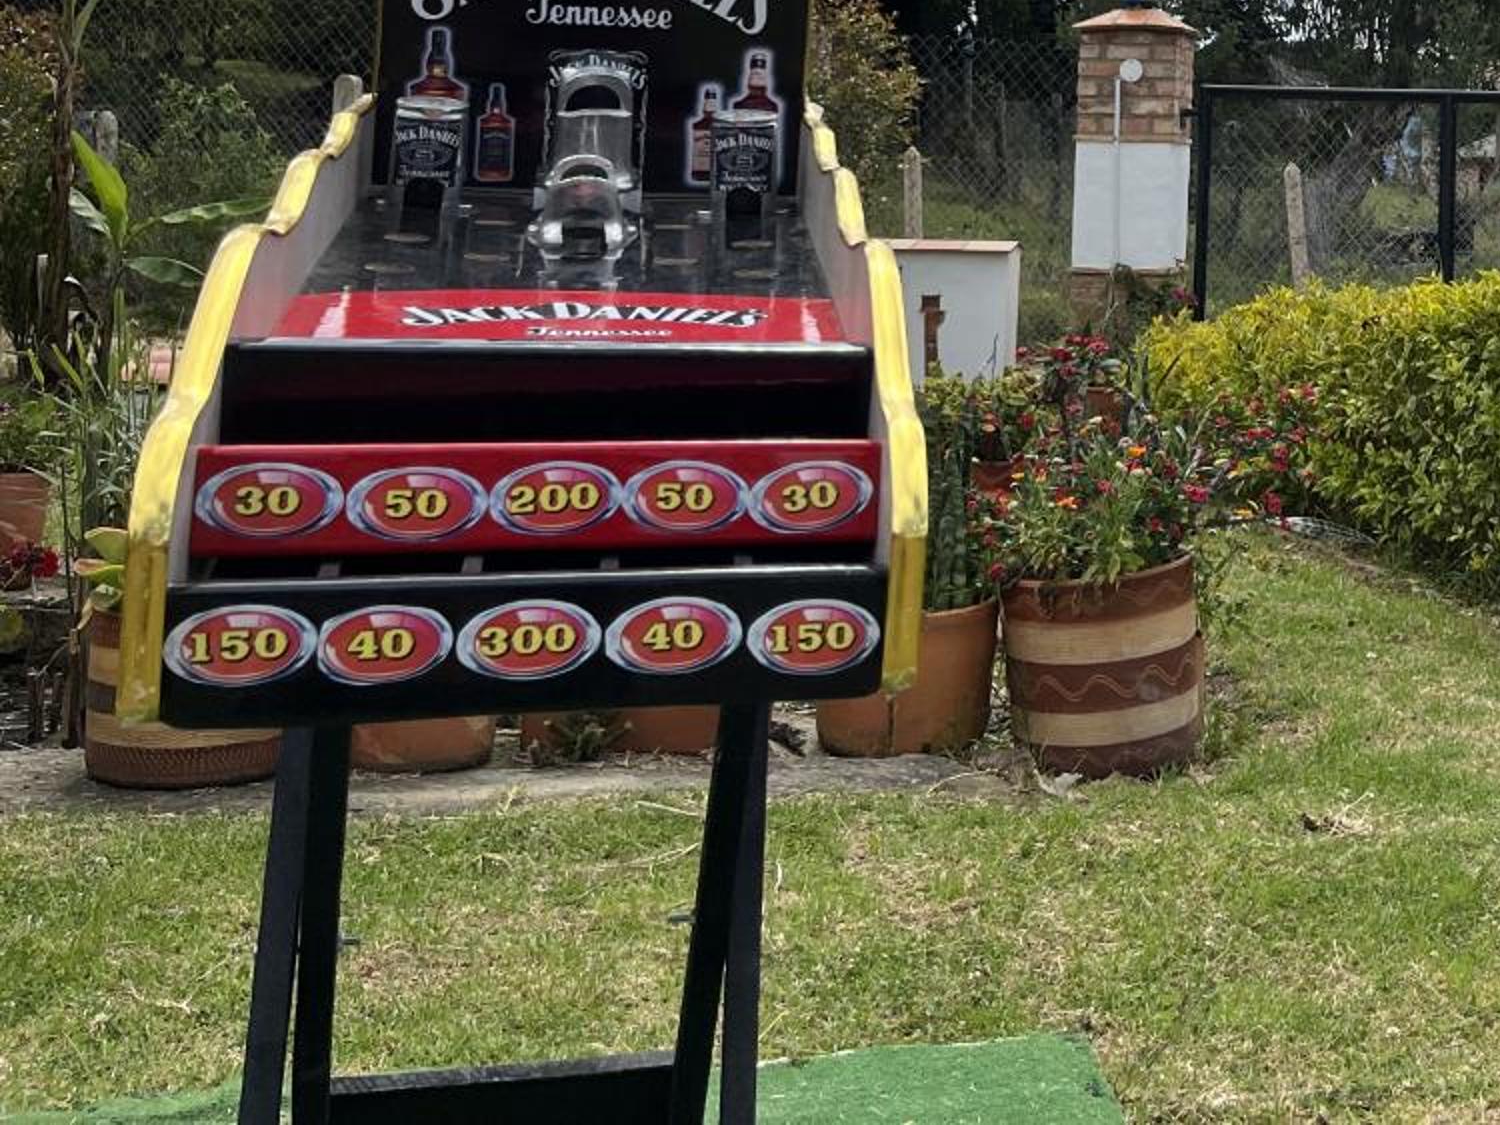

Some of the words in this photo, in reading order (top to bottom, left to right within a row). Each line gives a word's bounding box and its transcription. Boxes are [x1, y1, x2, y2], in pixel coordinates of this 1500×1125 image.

[549, 62, 587, 87] JCK
[401, 305, 544, 326] JACK
[550, 301, 768, 327] DANIEL'S
[526, 326, 674, 337] Tennessee
[235, 486, 300, 516] 30
[384, 489, 448, 518] 50
[509, 482, 599, 515] 200
[656, 482, 713, 511] 50
[782, 481, 838, 512] 30
[190, 628, 288, 662] 150
[348, 628, 414, 659] 40
[480, 623, 576, 657] 300
[643, 620, 703, 651] 40
[770, 621, 855, 653] 150
